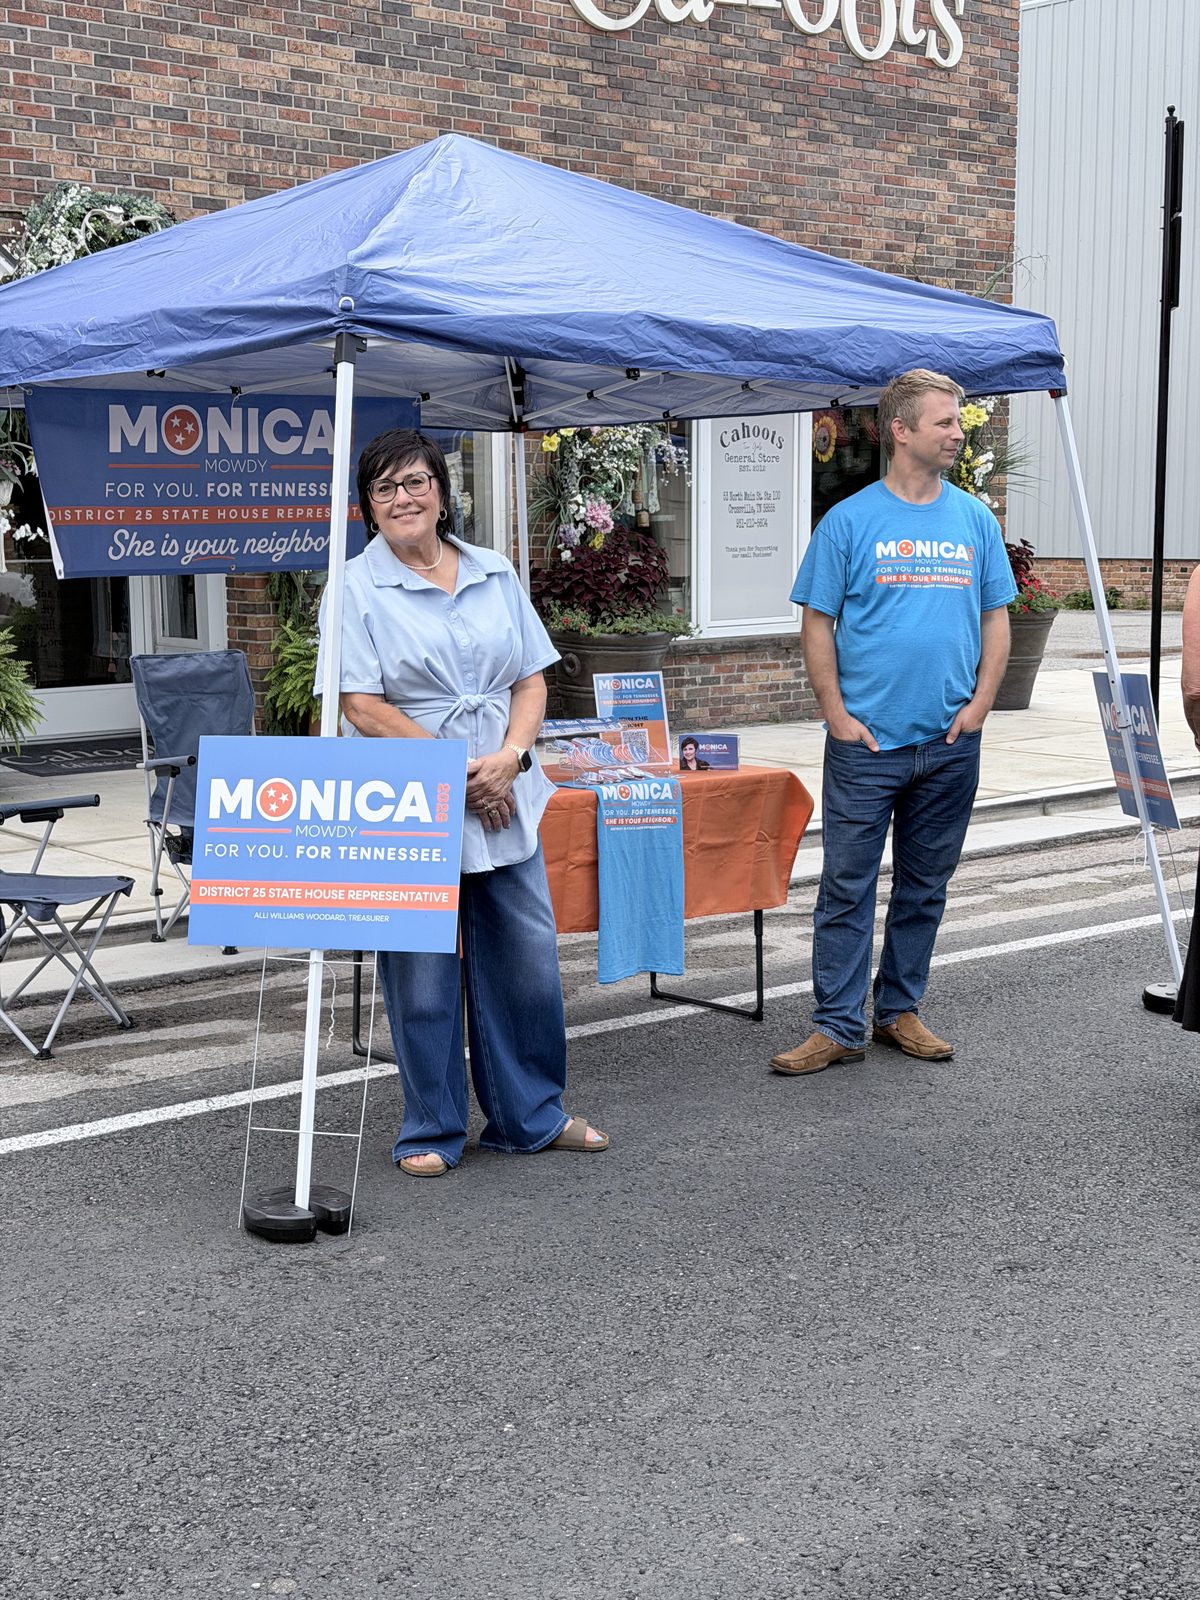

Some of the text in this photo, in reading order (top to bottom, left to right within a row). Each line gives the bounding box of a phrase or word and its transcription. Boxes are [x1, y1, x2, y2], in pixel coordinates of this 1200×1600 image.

[108, 404, 335, 455] MONICA
[720, 422, 785, 450] Cahoots
[205, 458, 268, 473] MOWDY
[724, 452, 780, 463] General Store
[105, 482, 352, 498] FOR YOU. FOR TENNESS.
[729, 491, 743, 501] North
[744, 491, 756, 501] Main
[49, 509, 126, 521] DISTRICT
[135, 509, 153, 521] 25
[162, 508, 209, 520] STATE
[217, 507, 270, 520] HOUSE
[108, 528, 155, 561] She
[161, 533, 178, 555] is
[181, 537, 239, 565] your
[876, 540, 969, 561] MONICA
[931, 576, 971, 585] NEIGHBOR.
[598, 678, 655, 690] MONICA
[1101, 702, 1151, 736] MOCA
[600, 782, 673, 800] MONICA
[208, 777, 433, 823] MONICA
[296, 825, 357, 838] MOWDY
[204, 844, 448, 862] FOR YOU. FOR TENNESSEE.
[199, 886, 449, 903] DISTRICT 25 STATE HOUSE REPRESENTATIVE
[254, 912, 390, 922] ALLI WILLIAMS WOODARD, TREASURER
